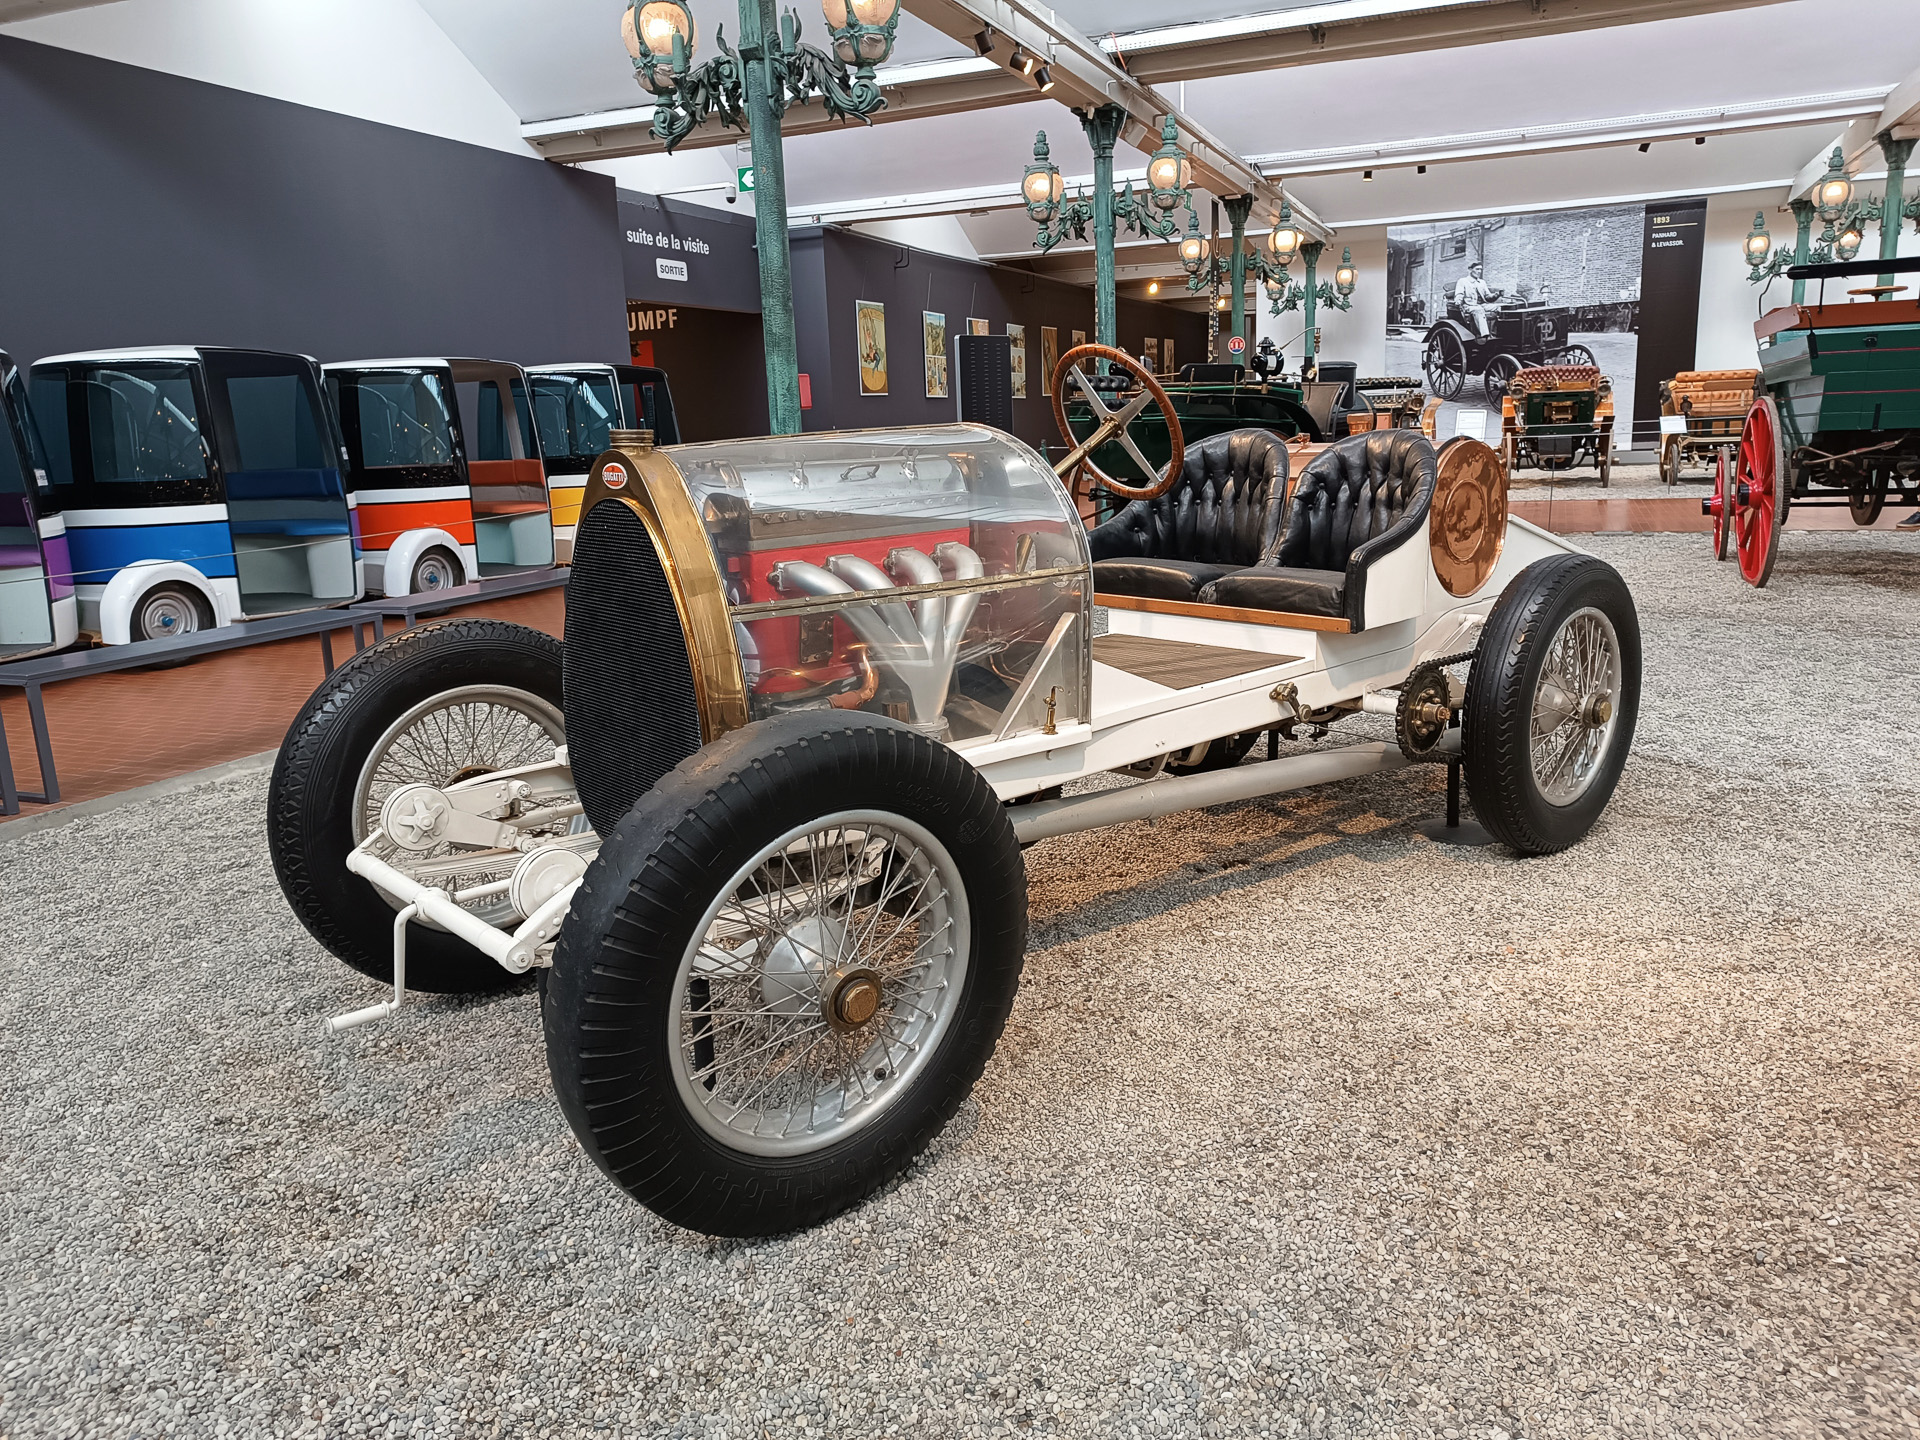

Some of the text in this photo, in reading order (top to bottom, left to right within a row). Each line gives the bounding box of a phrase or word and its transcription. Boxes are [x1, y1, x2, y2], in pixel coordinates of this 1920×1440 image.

[1653, 216, 1670, 224] 1893
[1652, 231, 1677, 239] PANHARD
[626, 228, 709, 254] suite de la visite
[660, 264, 684, 276] SORTIE
[603, 471, 627, 482] BUGATTI
